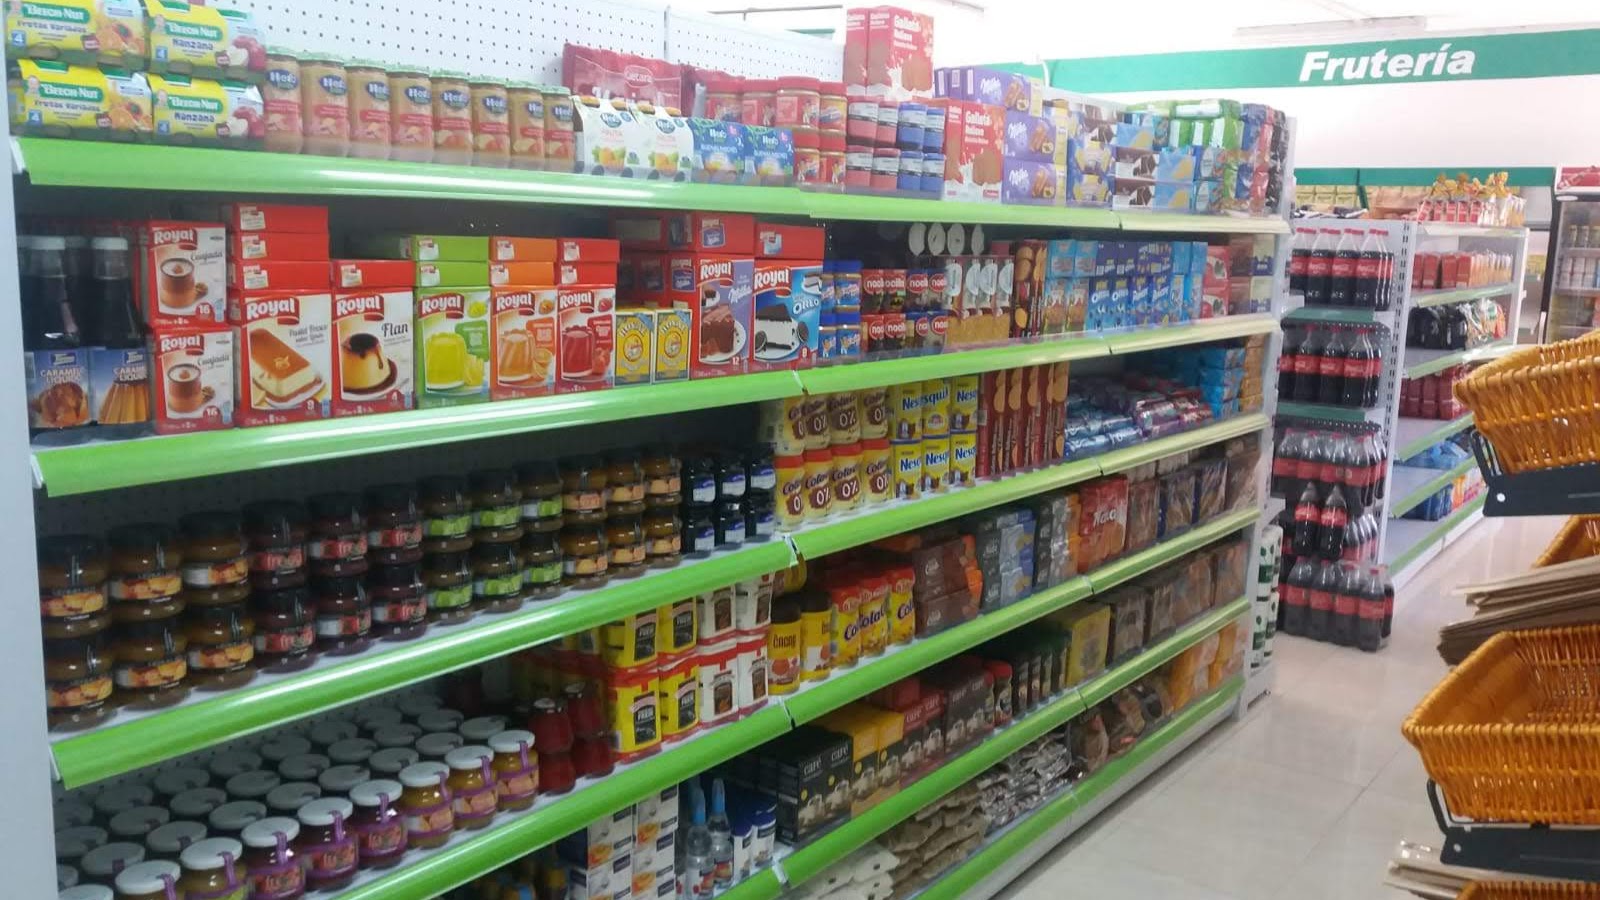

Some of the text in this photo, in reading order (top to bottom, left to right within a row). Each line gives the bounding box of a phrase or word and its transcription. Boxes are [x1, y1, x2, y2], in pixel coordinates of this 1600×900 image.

[173, 38, 213, 51] Manzana
[1299, 43, 1476, 82] Frutería
[175, 112, 214, 123] Manzana
[154, 228, 194, 245] Royal
[701, 262, 731, 280] Royal
[754, 268, 790, 290] Royal
[199, 304, 210, 315] 16
[246, 297, 296, 320] Royal
[337, 295, 381, 316] Royal
[422, 295, 461, 315] Royal
[496, 293, 532, 312] Royal
[559, 291, 592, 310] Royal
[381, 323, 409, 338] Flan
[161, 335, 201, 351] Royal
[732, 356, 740, 366] 12
[206, 407, 218, 417] 16
[839, 409, 856, 427] 0%
[817, 486, 833, 506] 0%
[842, 480, 859, 498] 0%
[831, 743, 849, 763] café
[803, 755, 822, 777] café
